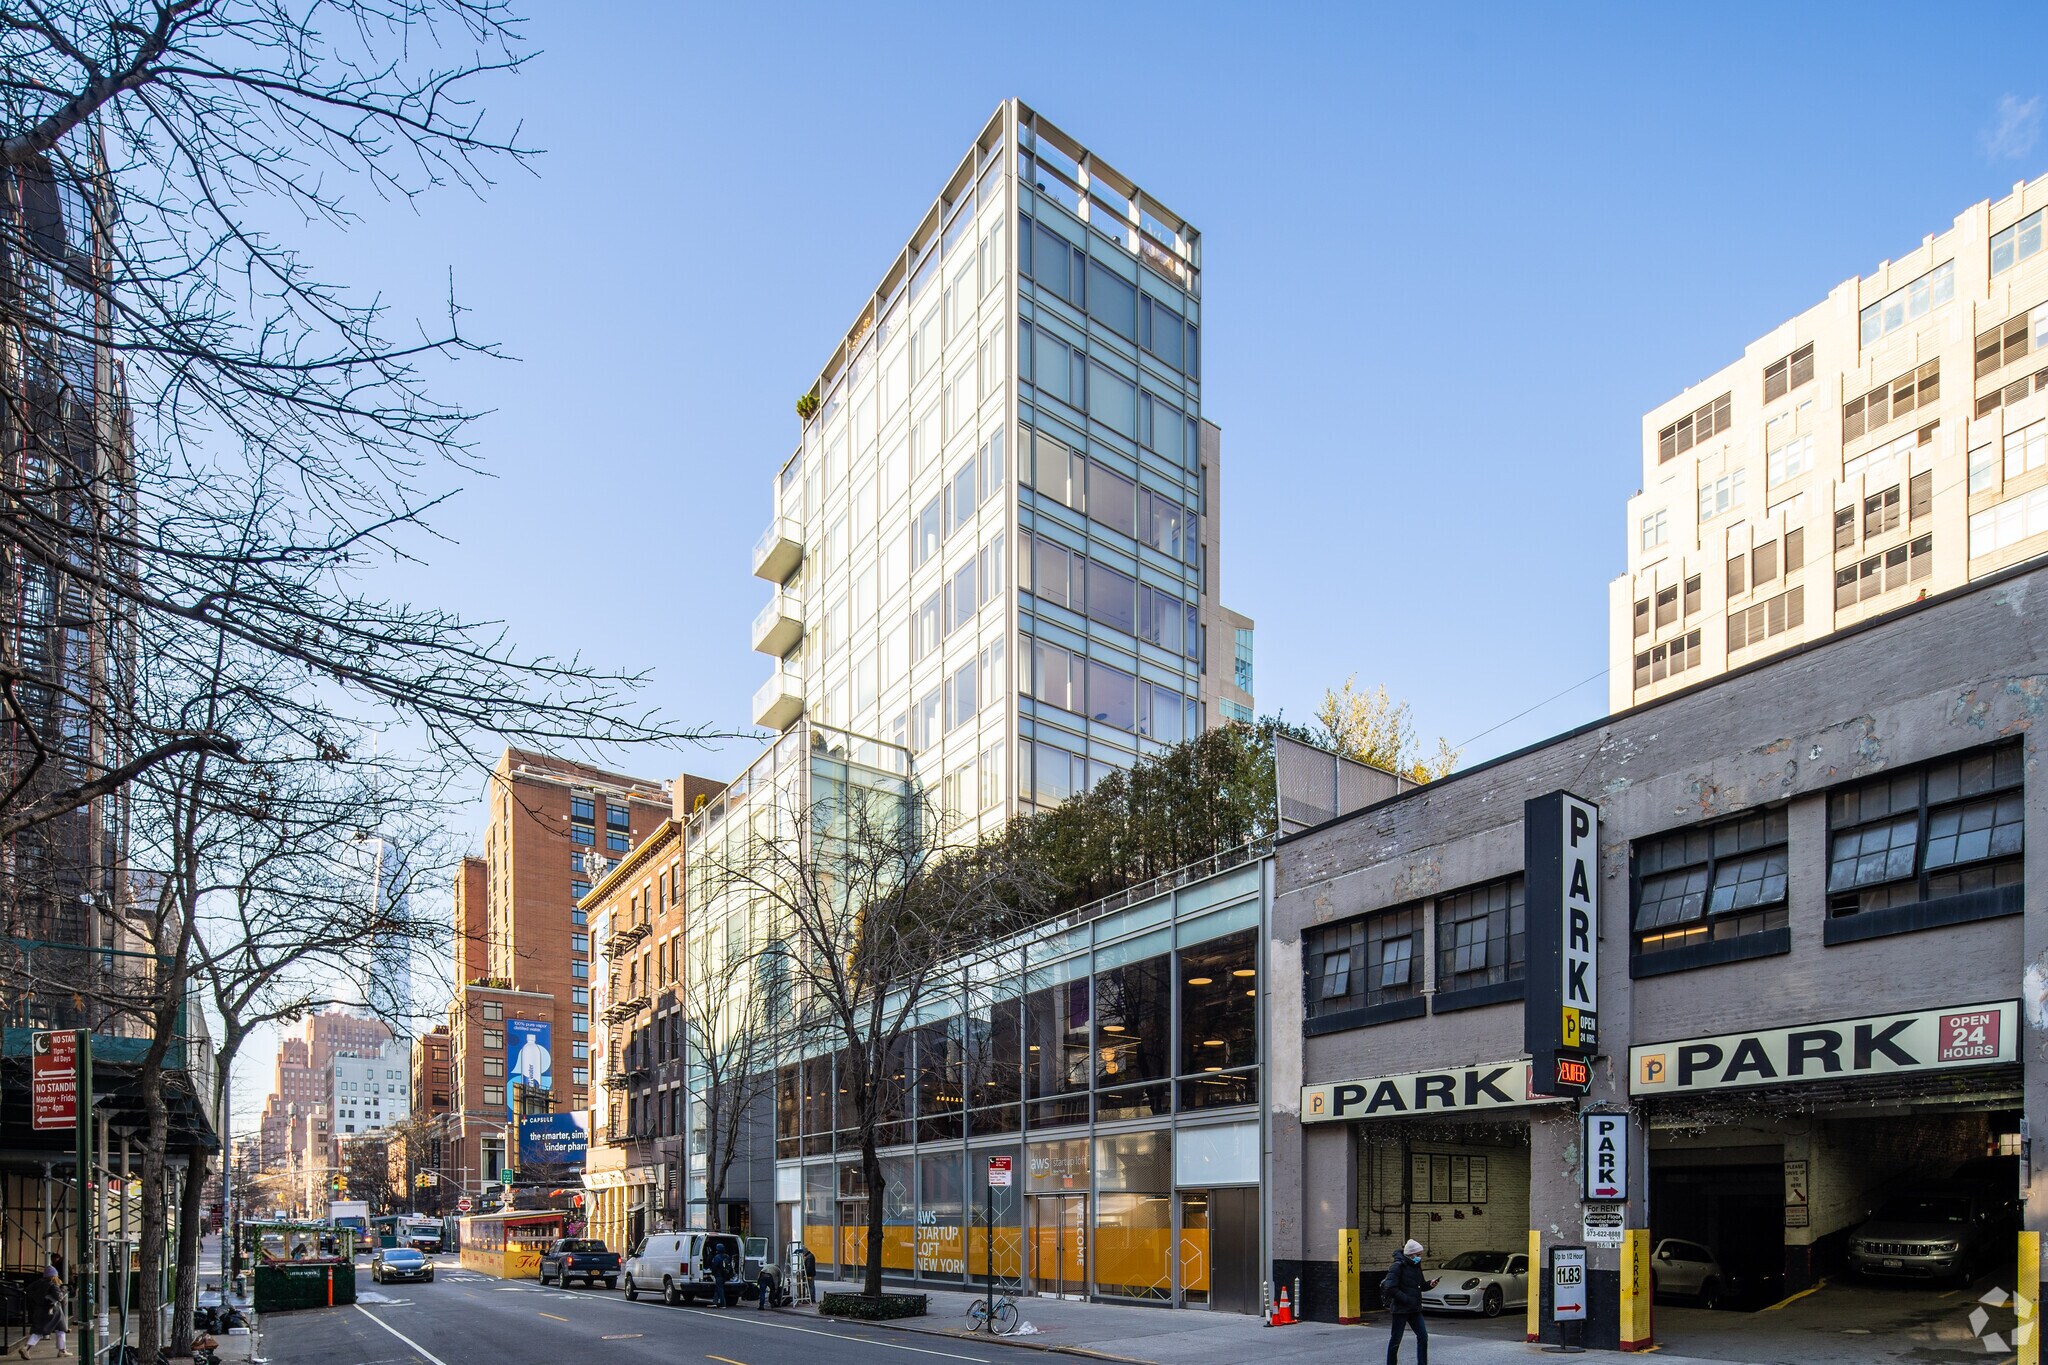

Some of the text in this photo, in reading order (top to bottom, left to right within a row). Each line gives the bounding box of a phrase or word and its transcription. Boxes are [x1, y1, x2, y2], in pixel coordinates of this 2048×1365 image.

[1569, 805, 1590, 1003] PARK
[1580, 1015, 1596, 1031] OPEN
[1950, 1015, 1989, 1027] OPEN
[62, 1034, 76, 1042] STAN
[1580, 1032, 1596, 1044] 24 HRS.
[1952, 1026, 1986, 1046] 24
[1678, 1019, 1921, 1086] PARK
[1944, 1045, 1994, 1058] HOURS
[36, 1082, 76, 1093] NO STANDIN
[1333, 1067, 1514, 1116] PARK
[36, 1096, 56, 1104] Monday
[60, 1094, 76, 1102] Friday
[52, 1104, 64, 1112] 4pm
[530, 1132, 541, 1140] the
[572, 1130, 588, 1140] simp
[544, 1142, 566, 1151] kinder
[1598, 1122, 1615, 1183] PARK
[1030, 1158, 1049, 1170] aws
[918, 1210, 936, 1224] AWS
[918, 1226, 958, 1240] STARTUP
[918, 1242, 940, 1256] LOFT
[515, 1256, 541, 1268] Fél
[918, 1258, 964, 1273] NEW YORK
[1558, 1268, 1580, 1283] 11.83
